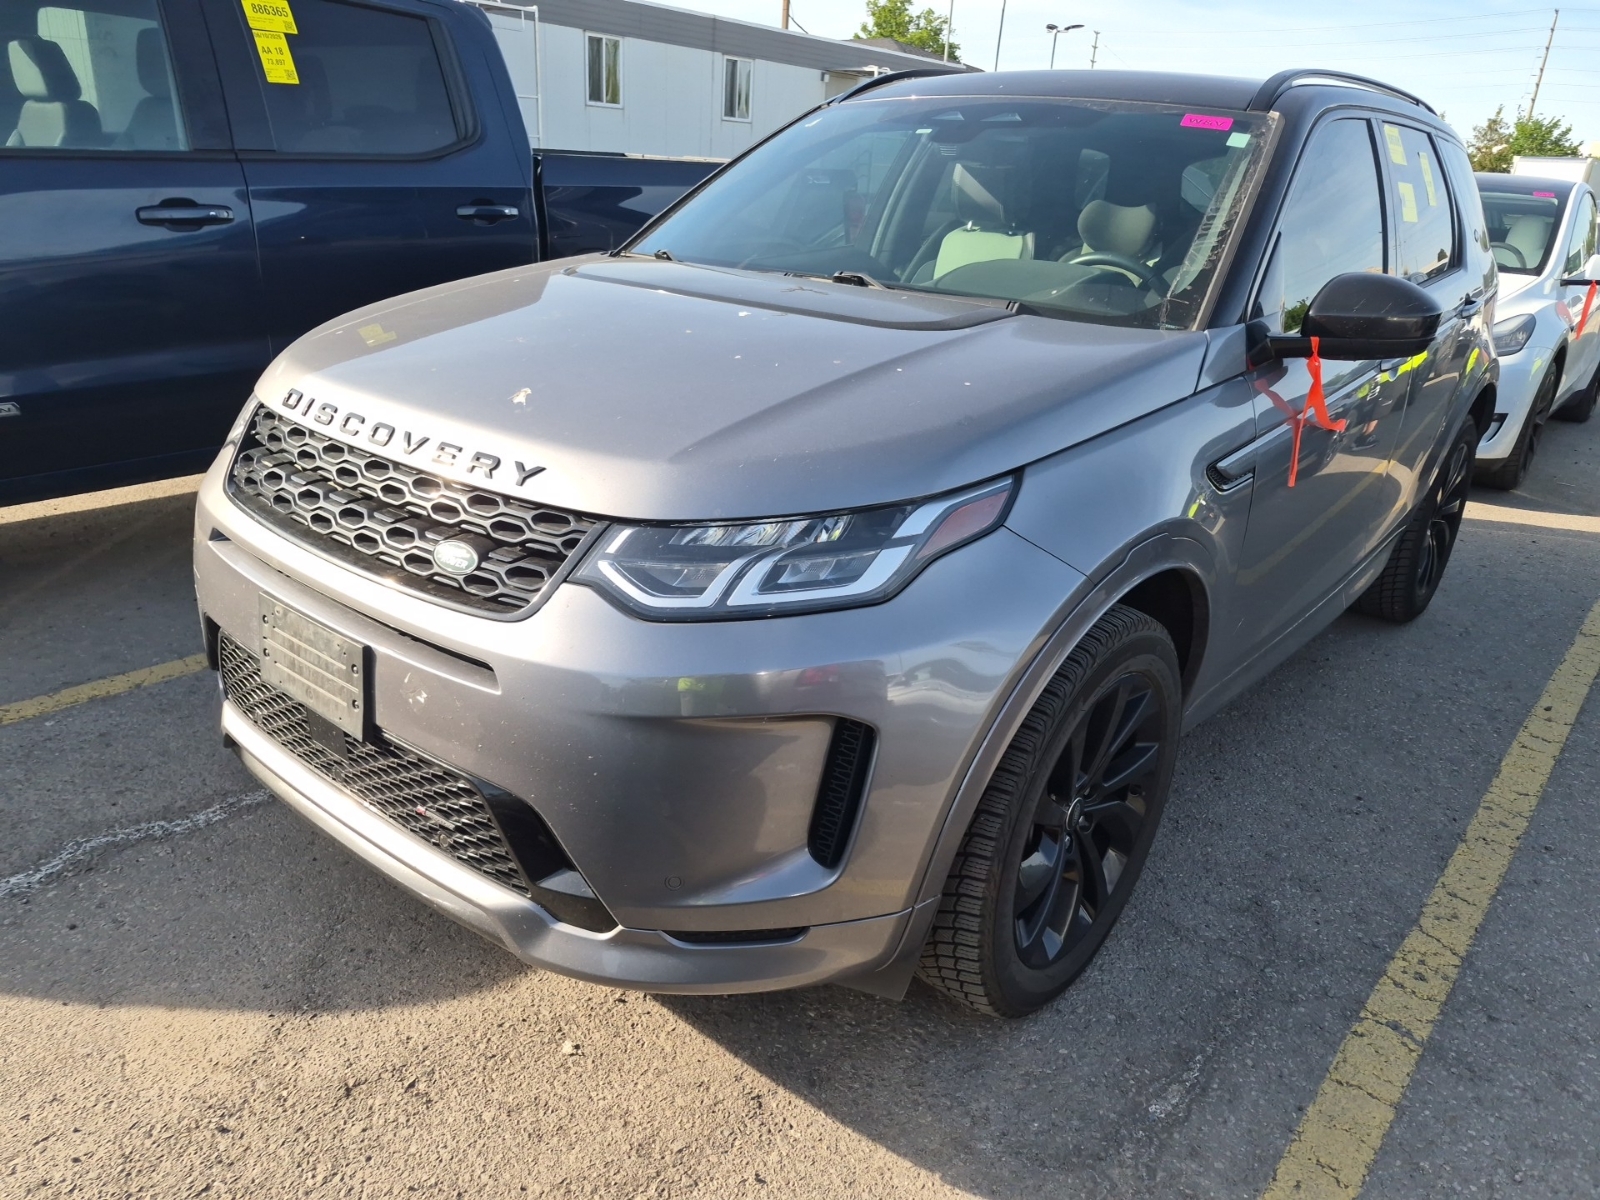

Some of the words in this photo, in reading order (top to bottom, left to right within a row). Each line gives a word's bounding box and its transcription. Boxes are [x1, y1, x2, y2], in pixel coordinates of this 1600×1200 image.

[251, 3, 288, 17] 886365
[262, 46, 272, 54] AA
[274, 47, 284, 55] 18
[282, 388, 547, 487] DISCOVERY
